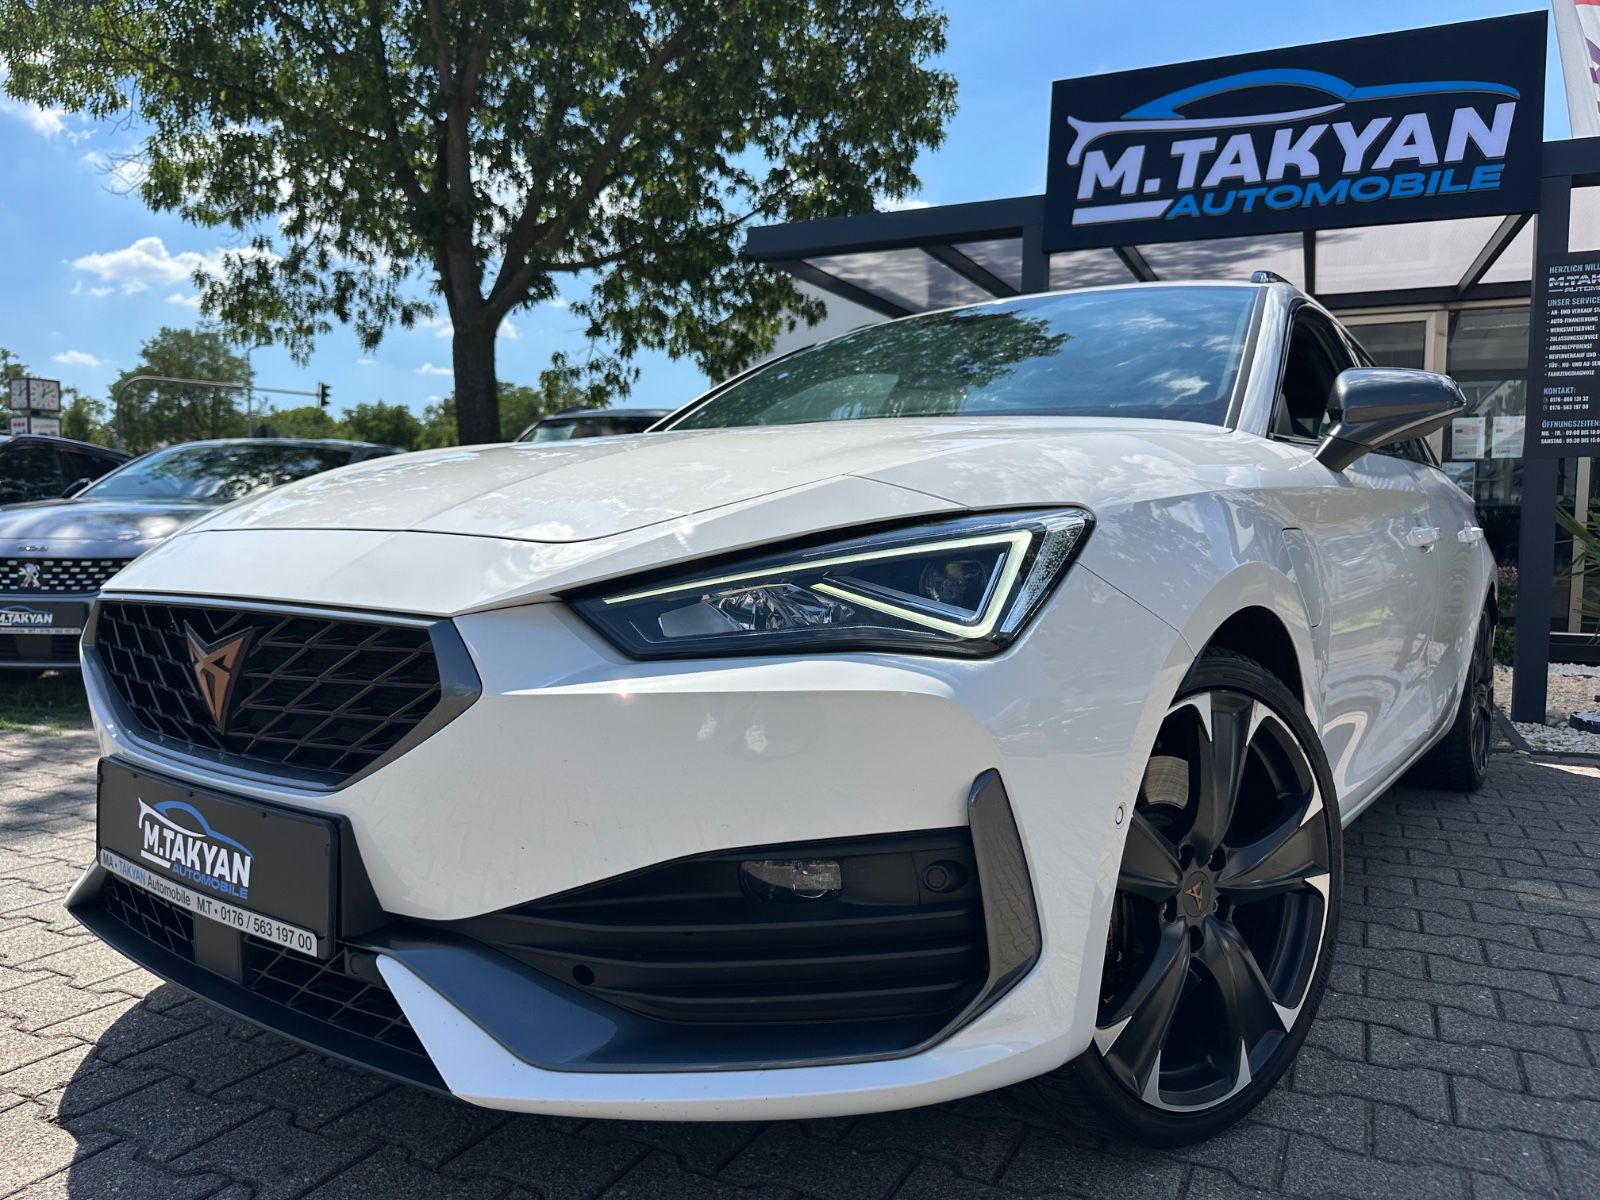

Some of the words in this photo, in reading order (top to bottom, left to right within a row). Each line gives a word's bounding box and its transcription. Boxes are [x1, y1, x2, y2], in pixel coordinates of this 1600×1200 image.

[1077, 102, 1517, 200] M.TAKYAN
[1165, 164, 1505, 220] AUTOMOBILE
[1550, 264, 1582, 274] HERZLICH
[1548, 298, 1570, 307] UNSER
[1542, 419, 1600, 428] ÖFFNUNGSZEITEN:
[144, 820, 250, 887] M.TAKYAN
[102, 852, 114, 869] MA
[118, 860, 146, 885] TAKYAN
[147, 875, 191, 906] Automobile
[221, 906, 244, 926] 0176
[254, 918, 272, 937] 563
[276, 926, 295, 944] 197
[298, 934, 312, 951] 00
[172, 863, 249, 899] AUTOMOBILE
